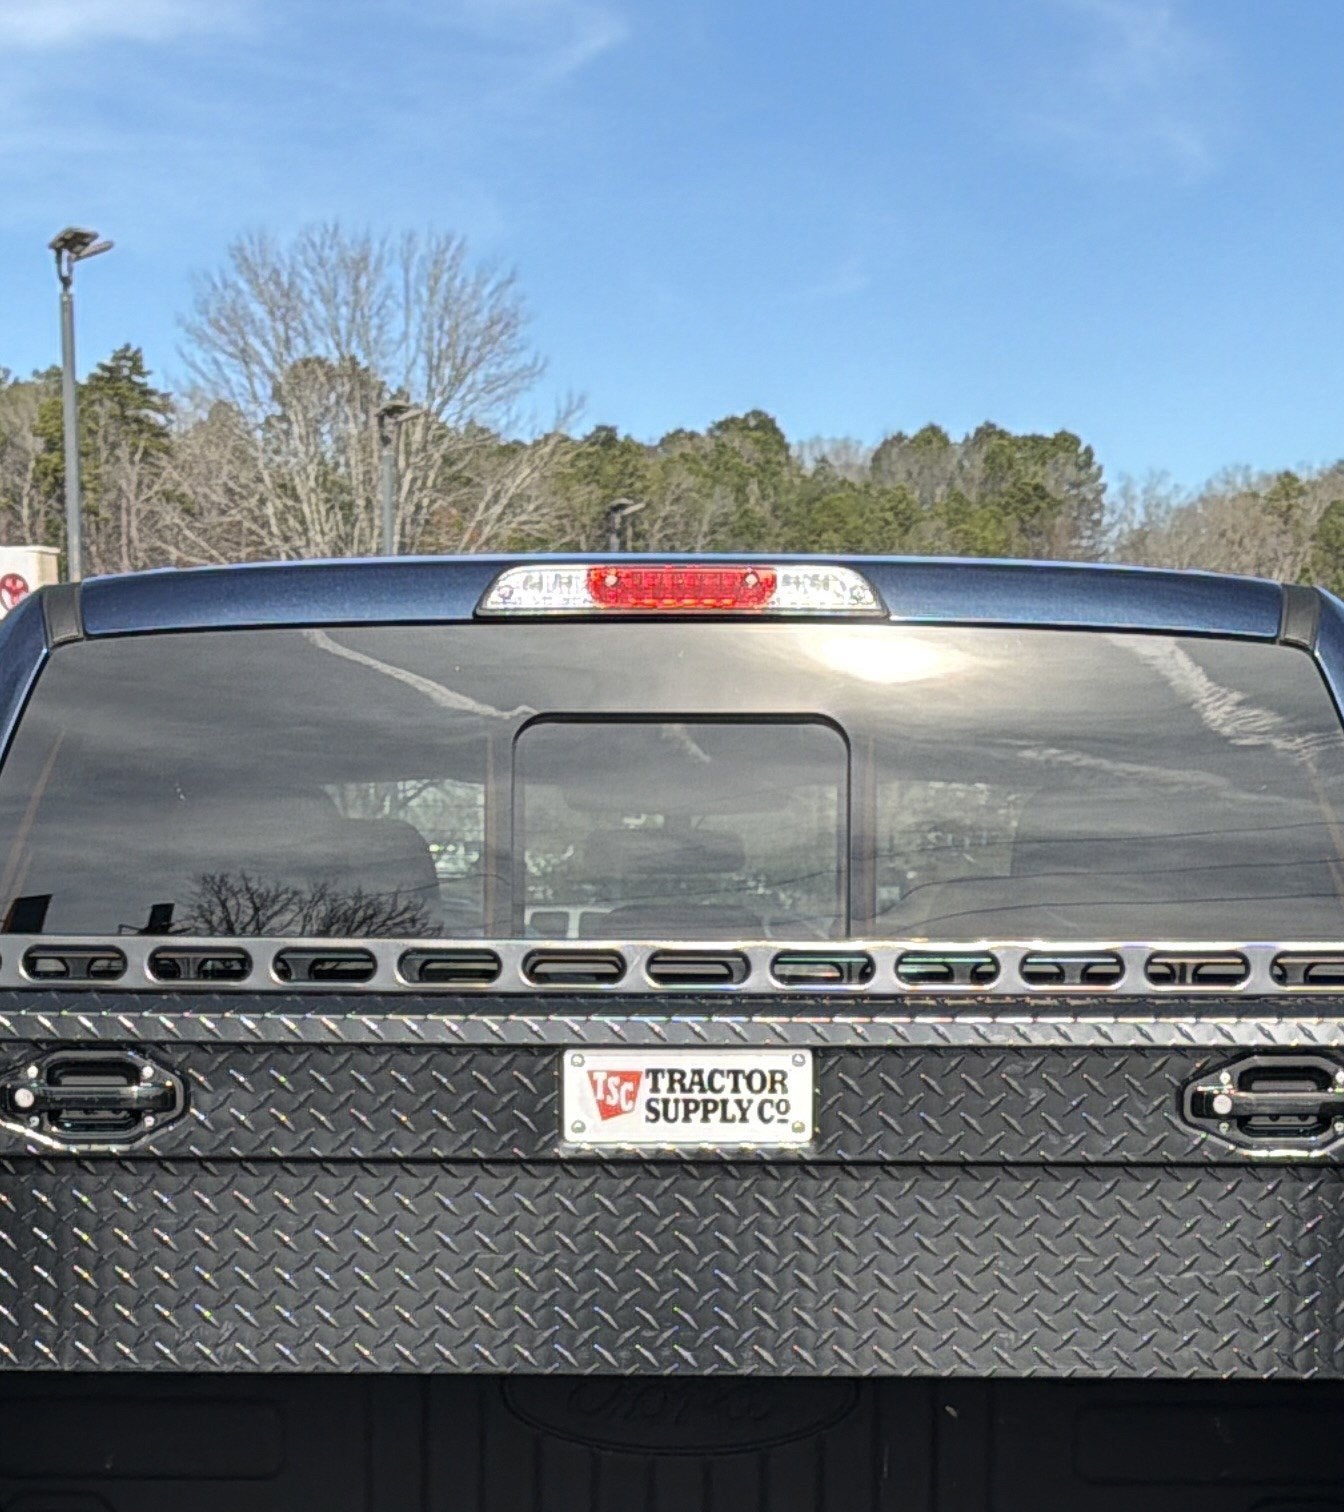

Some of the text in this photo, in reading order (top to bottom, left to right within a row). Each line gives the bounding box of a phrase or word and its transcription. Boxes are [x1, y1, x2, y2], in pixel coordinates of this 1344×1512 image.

[592, 1071, 636, 1111] TSC
[645, 1068, 789, 1094] TRACTOR
[645, 1098, 754, 1123] SUPPLY
